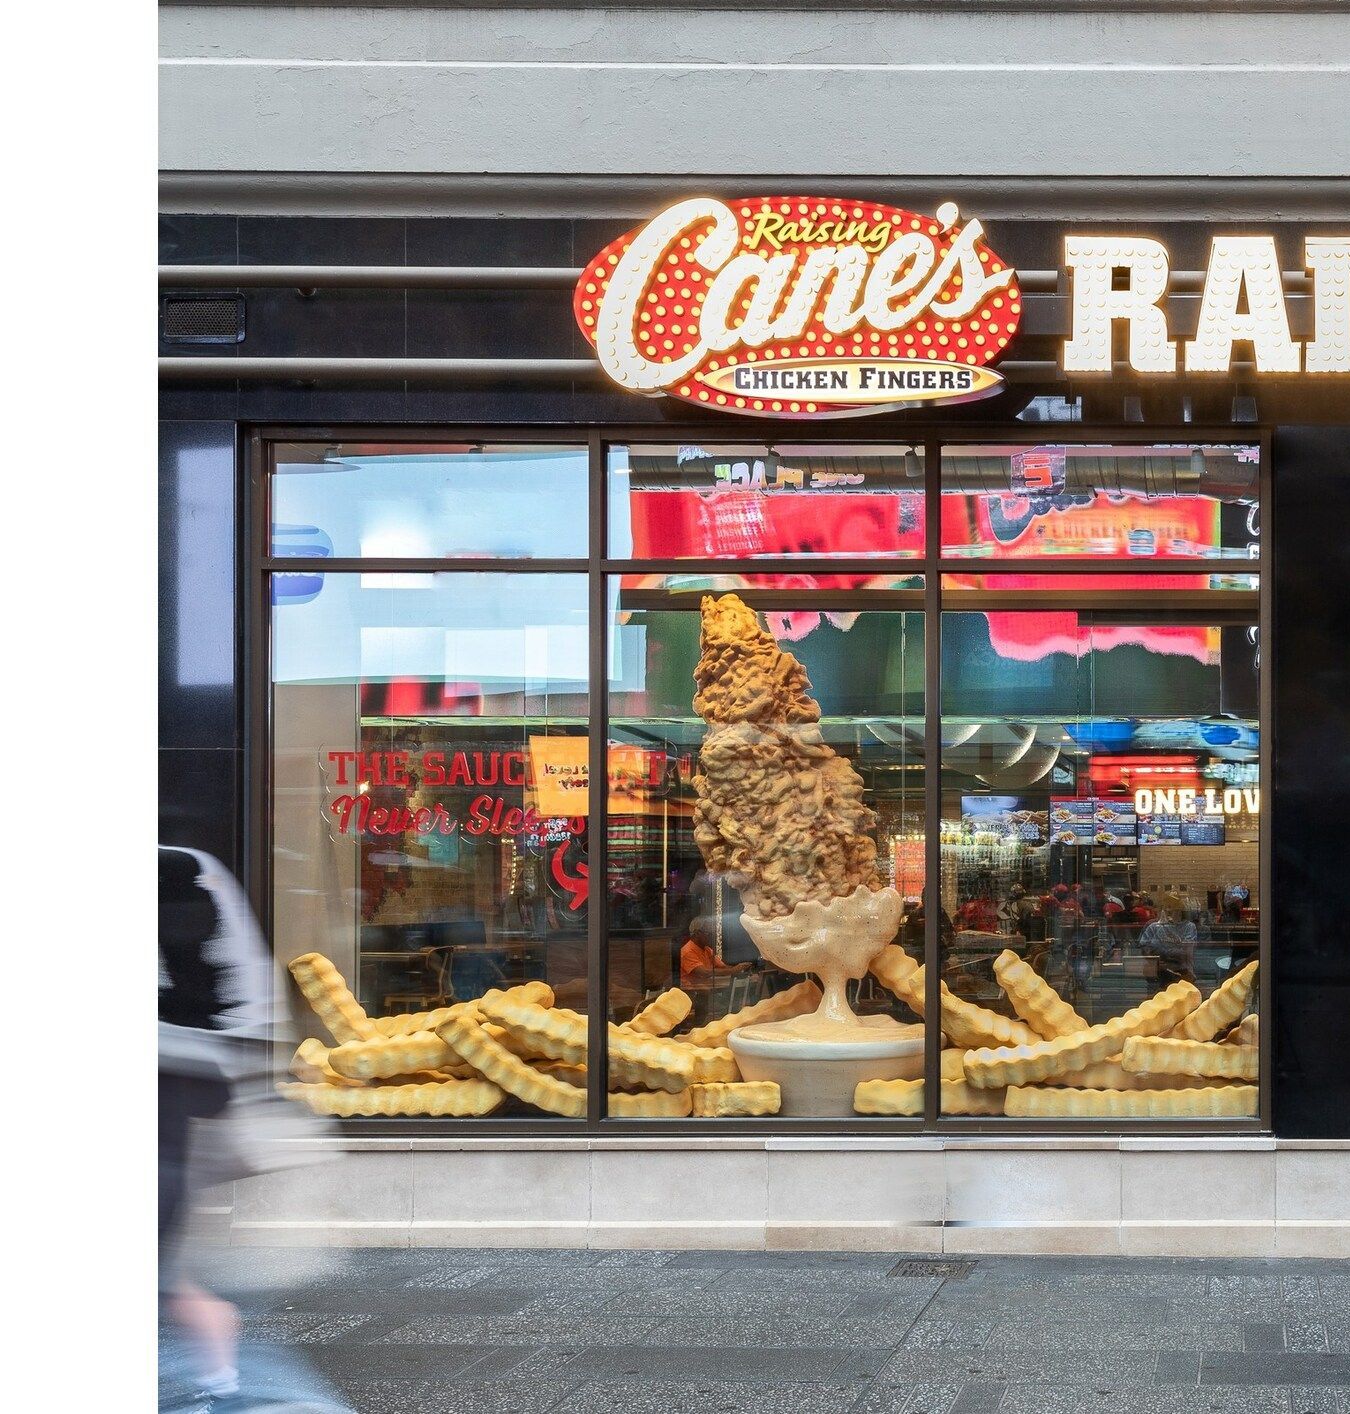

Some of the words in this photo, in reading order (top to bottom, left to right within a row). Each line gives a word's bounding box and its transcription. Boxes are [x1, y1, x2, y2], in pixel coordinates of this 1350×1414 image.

[748, 210, 894, 252] Raising
[596, 197, 1017, 393] Cane's
[734, 366, 849, 390] CHICKEN
[859, 366, 973, 390] FINGERS
[328, 751, 411, 786] THE
[331, 794, 458, 835] Never
[1134, 788, 1197, 814] ONE
